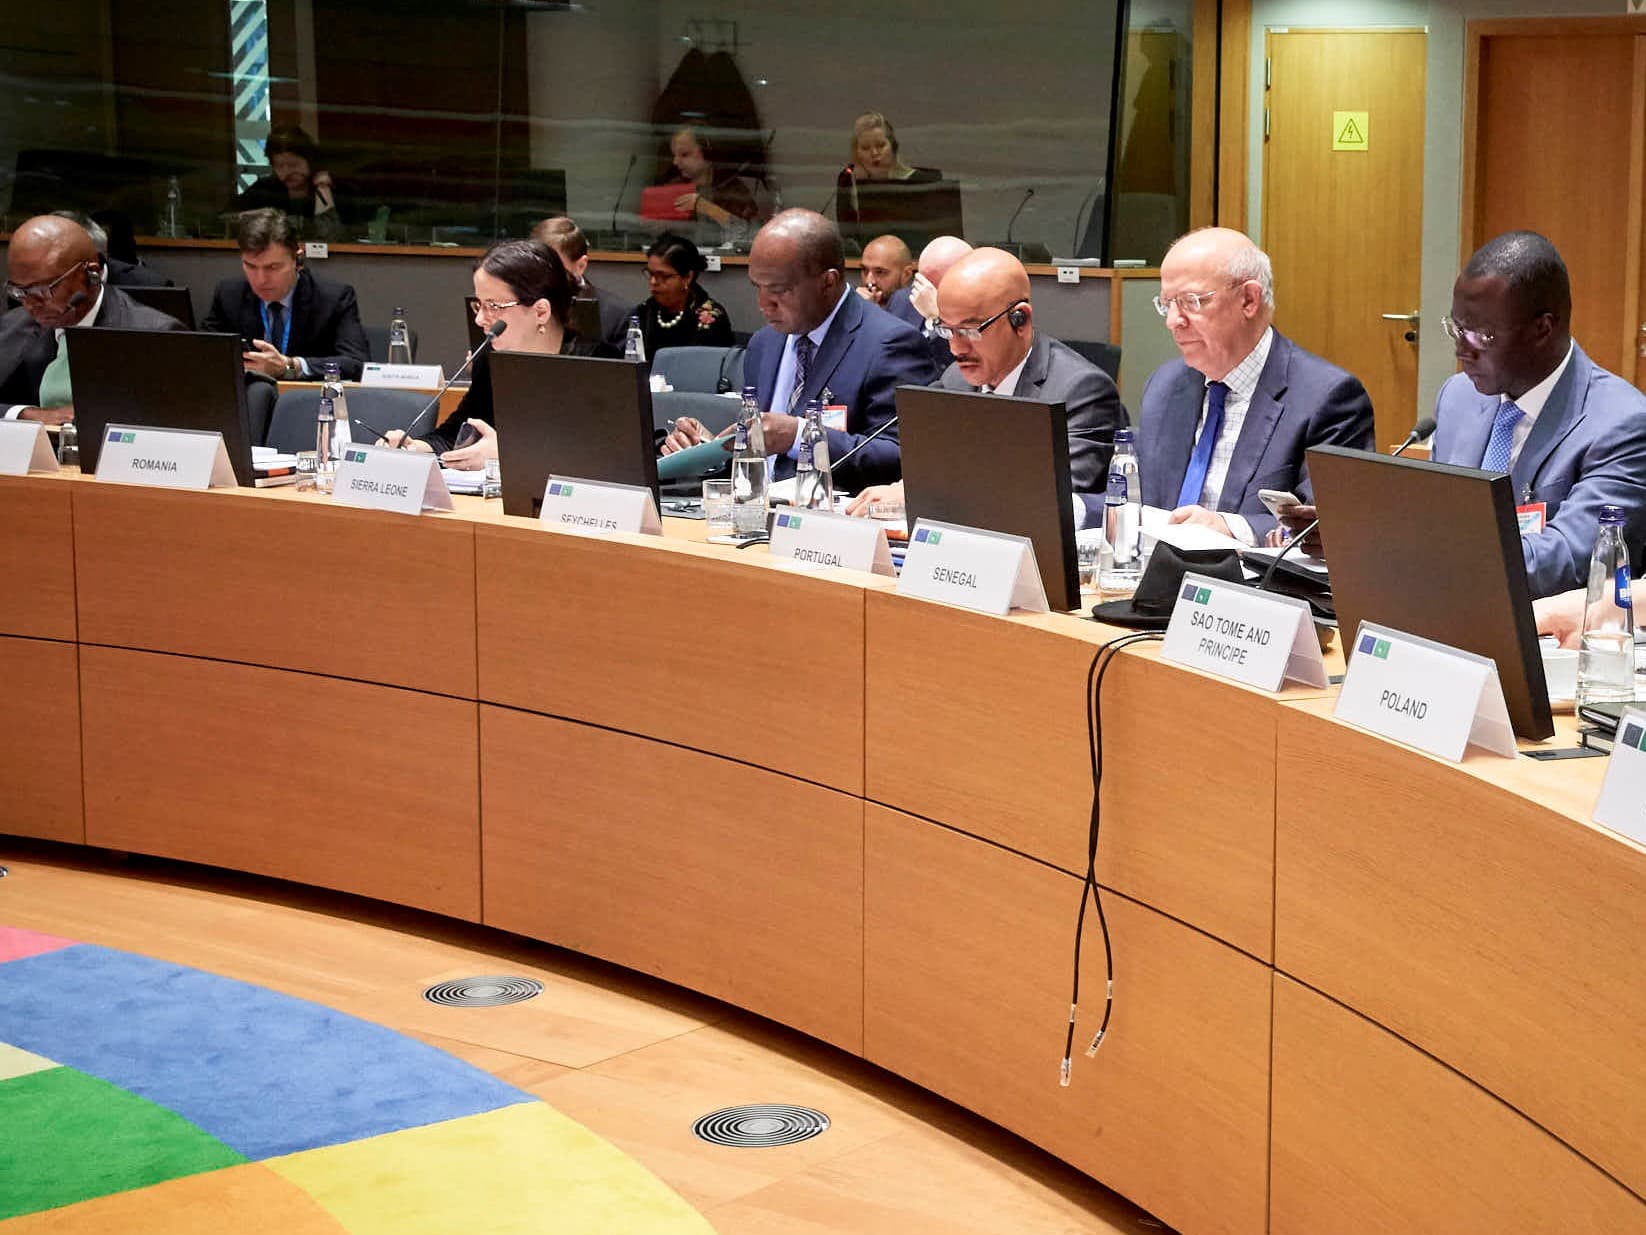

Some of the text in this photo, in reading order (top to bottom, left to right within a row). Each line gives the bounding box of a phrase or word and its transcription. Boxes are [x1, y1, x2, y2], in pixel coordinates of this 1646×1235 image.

[132, 458, 176, 472] ROMANIA
[351, 479, 408, 497] SIERRA LEONE
[794, 547, 843, 567] PORTUGAL
[933, 567, 977, 588] SENEGAL
[1191, 611, 1271, 645] SAO TOME AND
[1199, 638, 1248, 664] PRINCIPE
[1380, 689, 1427, 719] POLAND
